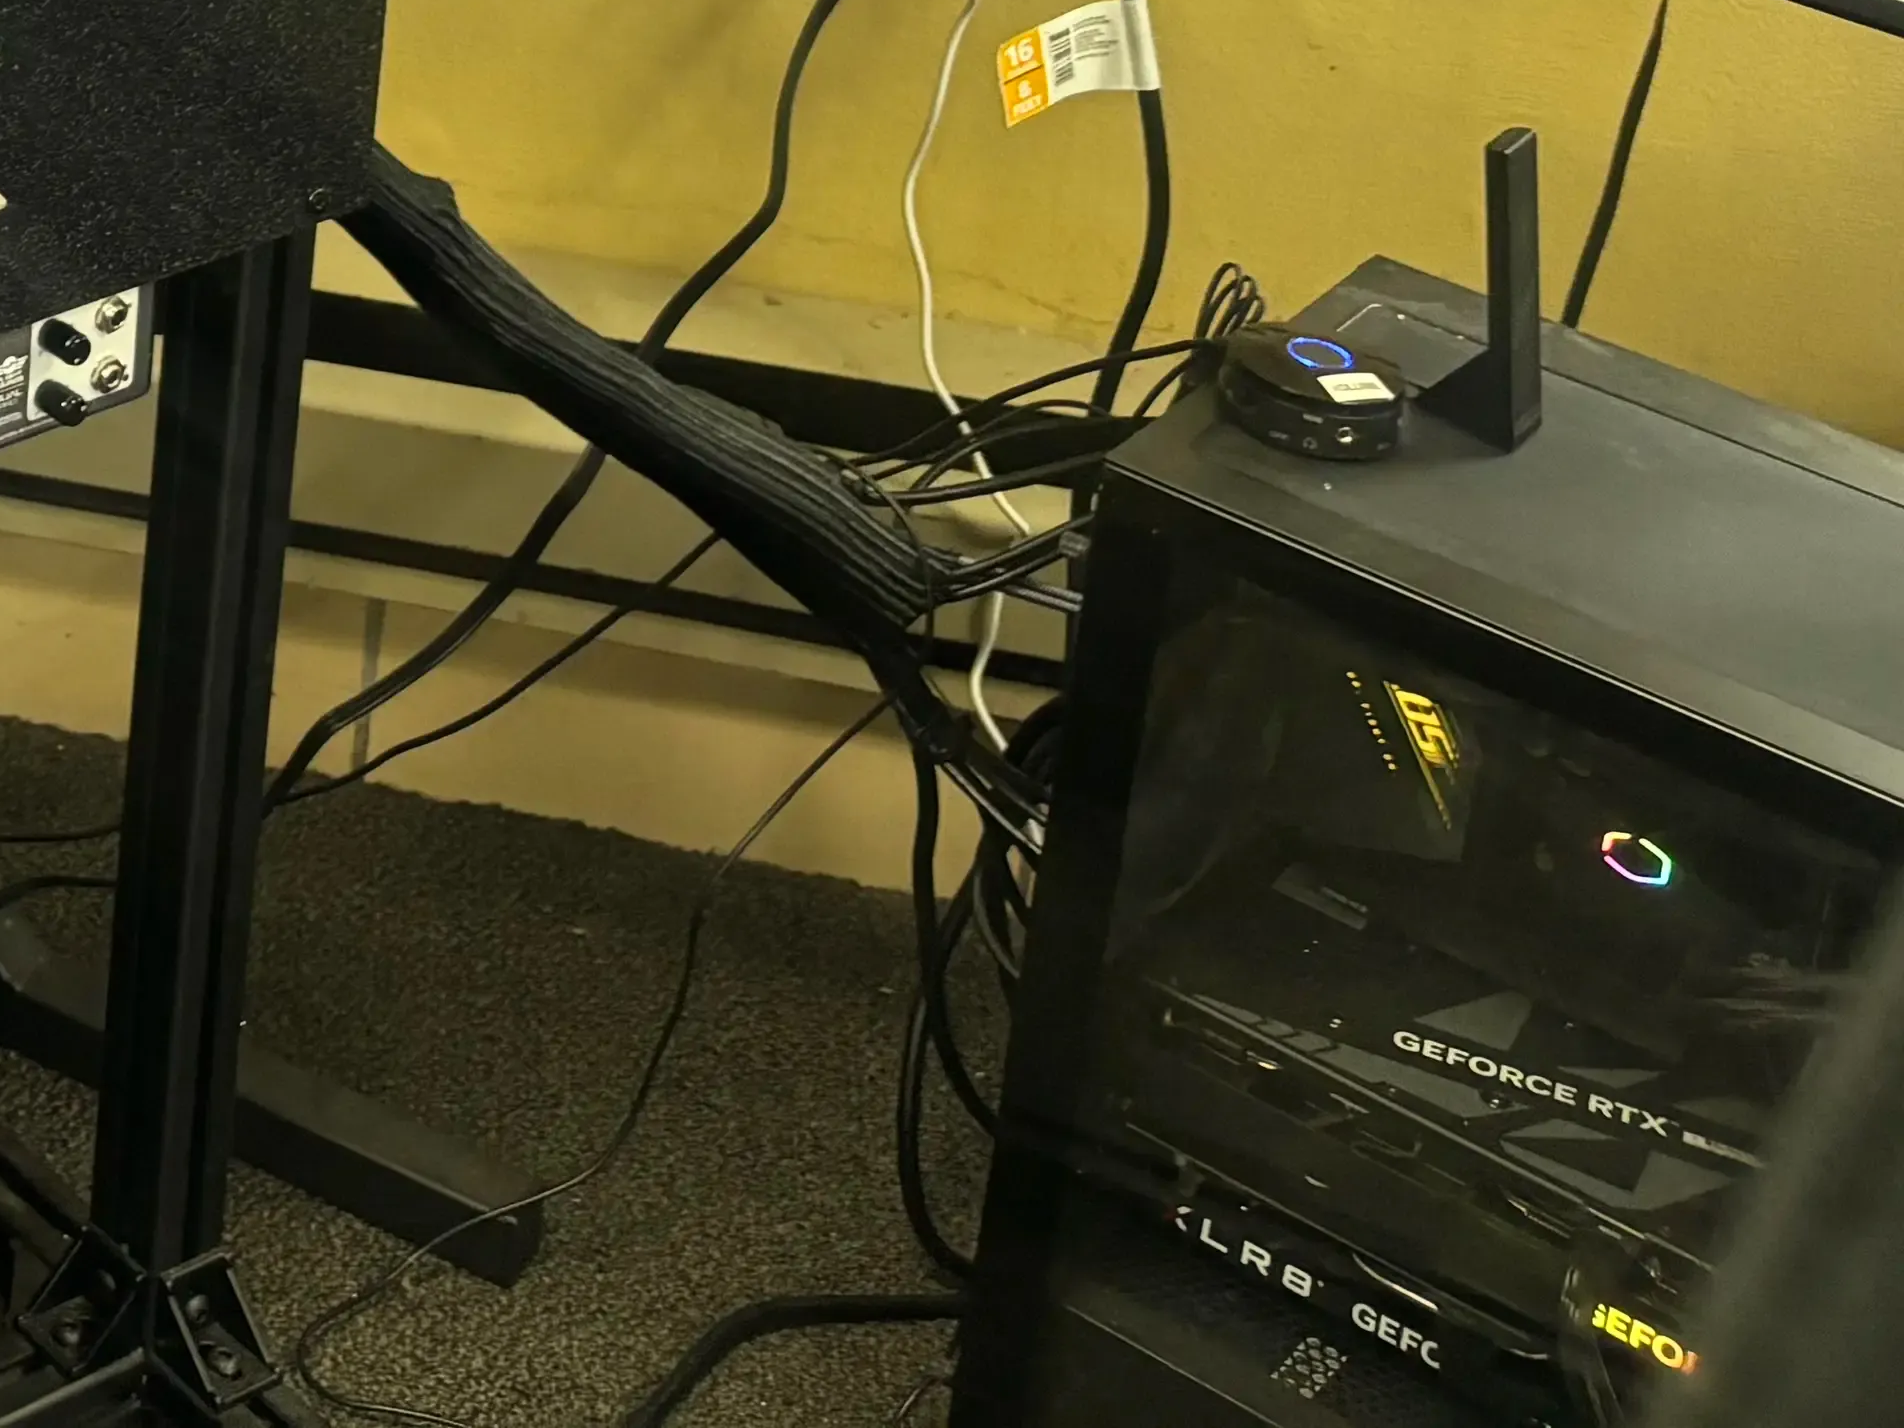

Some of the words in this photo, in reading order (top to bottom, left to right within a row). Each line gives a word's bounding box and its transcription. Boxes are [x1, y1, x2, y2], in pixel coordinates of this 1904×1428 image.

[1004, 37, 1034, 67] 16
[1393, 1031, 1577, 1106] GEFORCE
[1588, 1093, 1668, 1138] RTX
